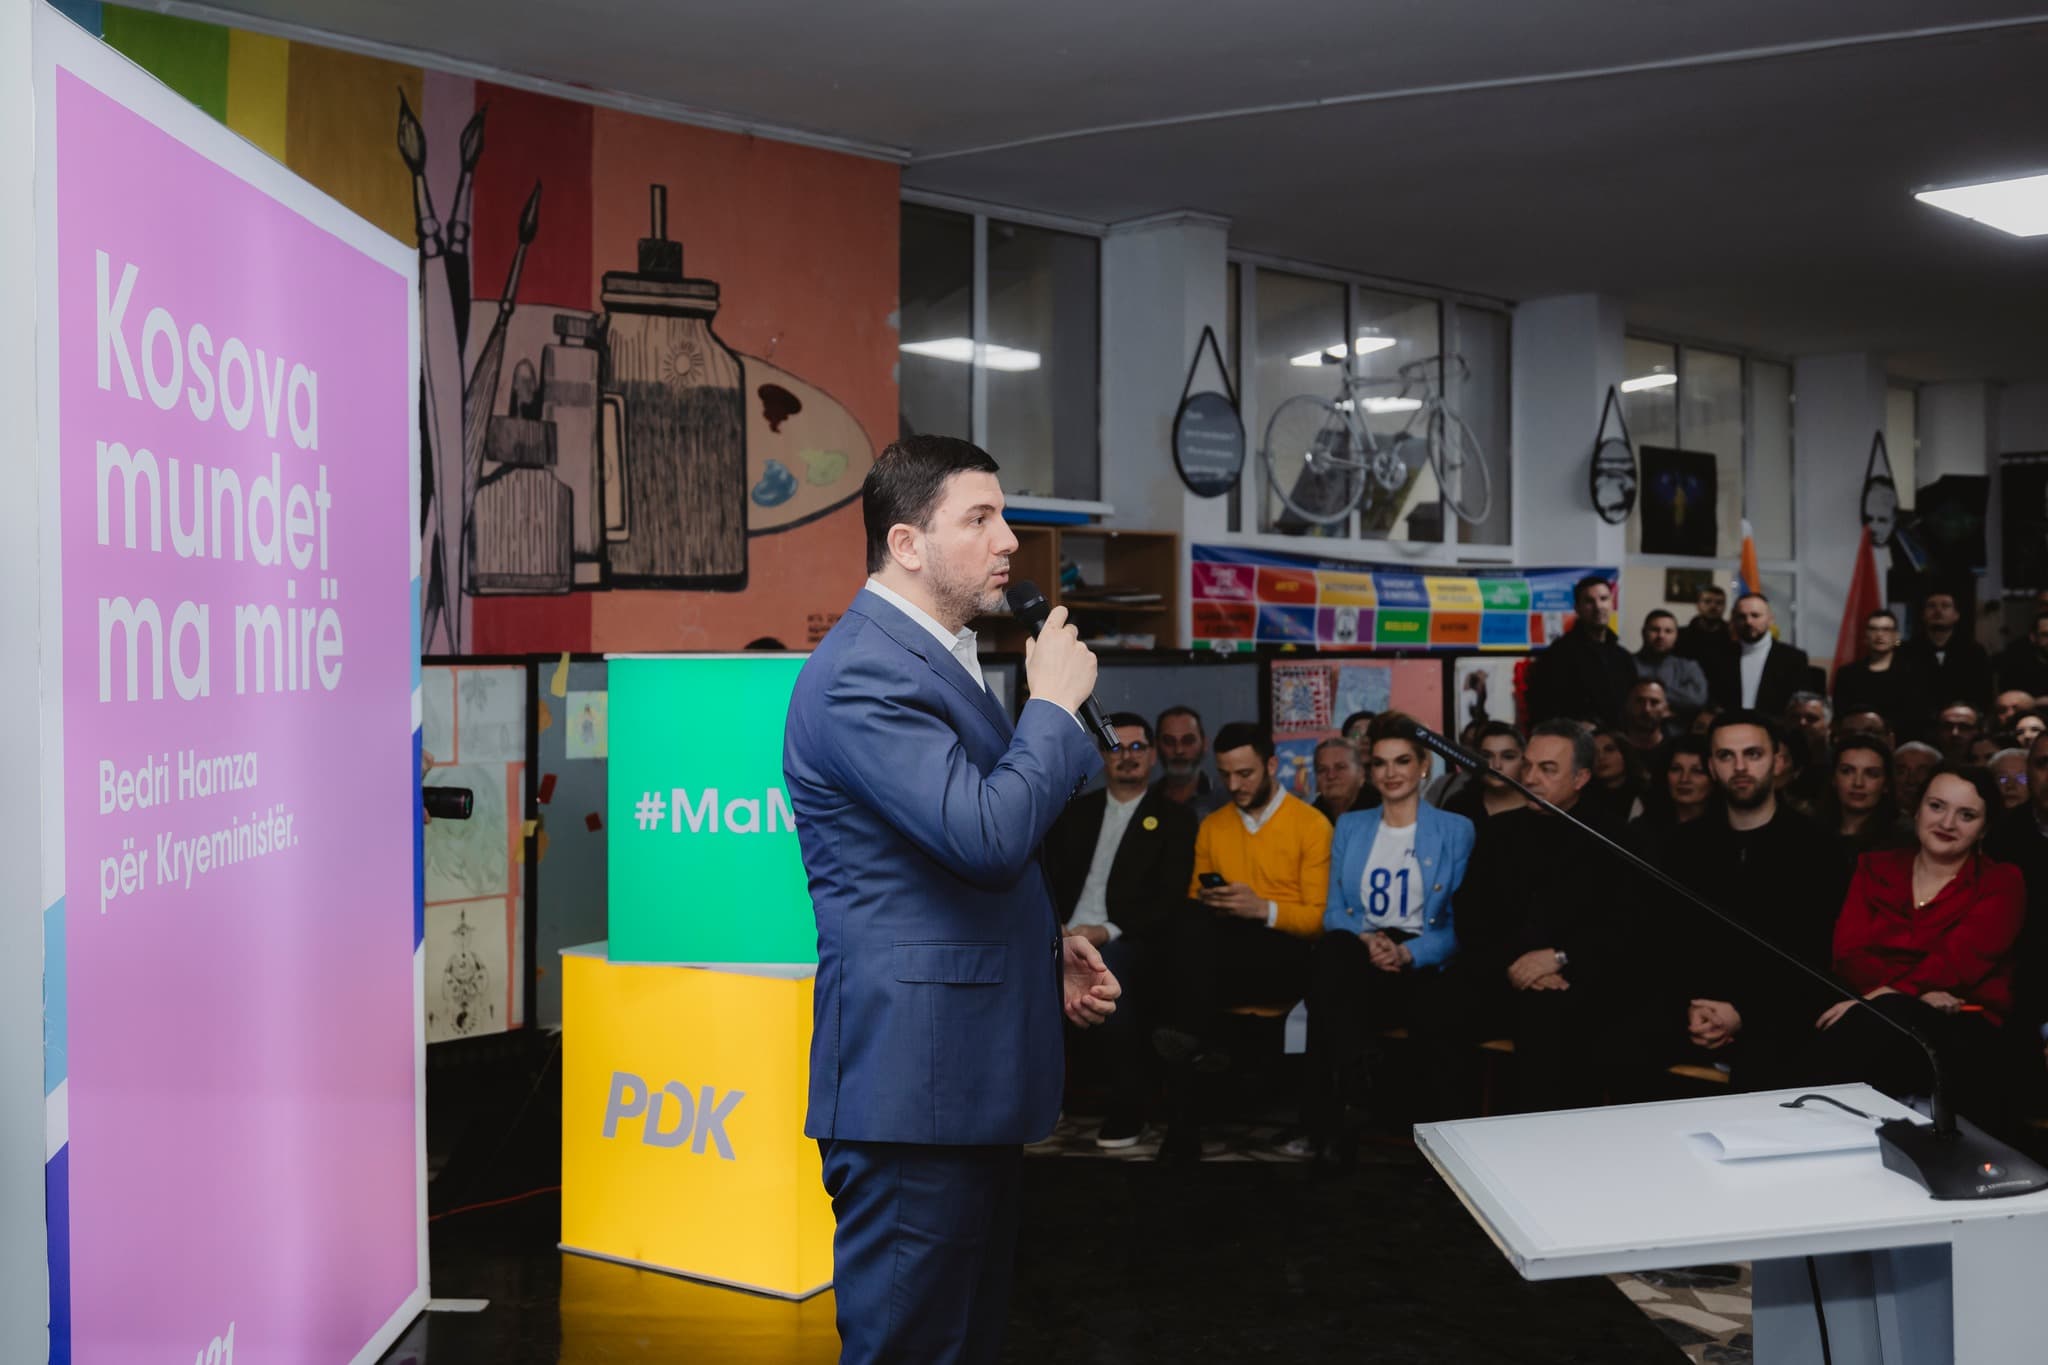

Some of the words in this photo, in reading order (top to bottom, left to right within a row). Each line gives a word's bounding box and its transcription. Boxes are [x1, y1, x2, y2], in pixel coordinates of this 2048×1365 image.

[95, 249, 319, 451] Kosova
[96, 439, 332, 570] mundet
[98, 596, 210, 703] ma
[235, 578, 343, 694] mirë
[99, 753, 169, 814] Bedri
[178, 749, 257, 801] Hamza
[100, 838, 148, 914] për
[156, 807, 299, 889] Kryeministër.
[1368, 867, 1410, 918] 81
[602, 1071, 746, 1161] PDK
